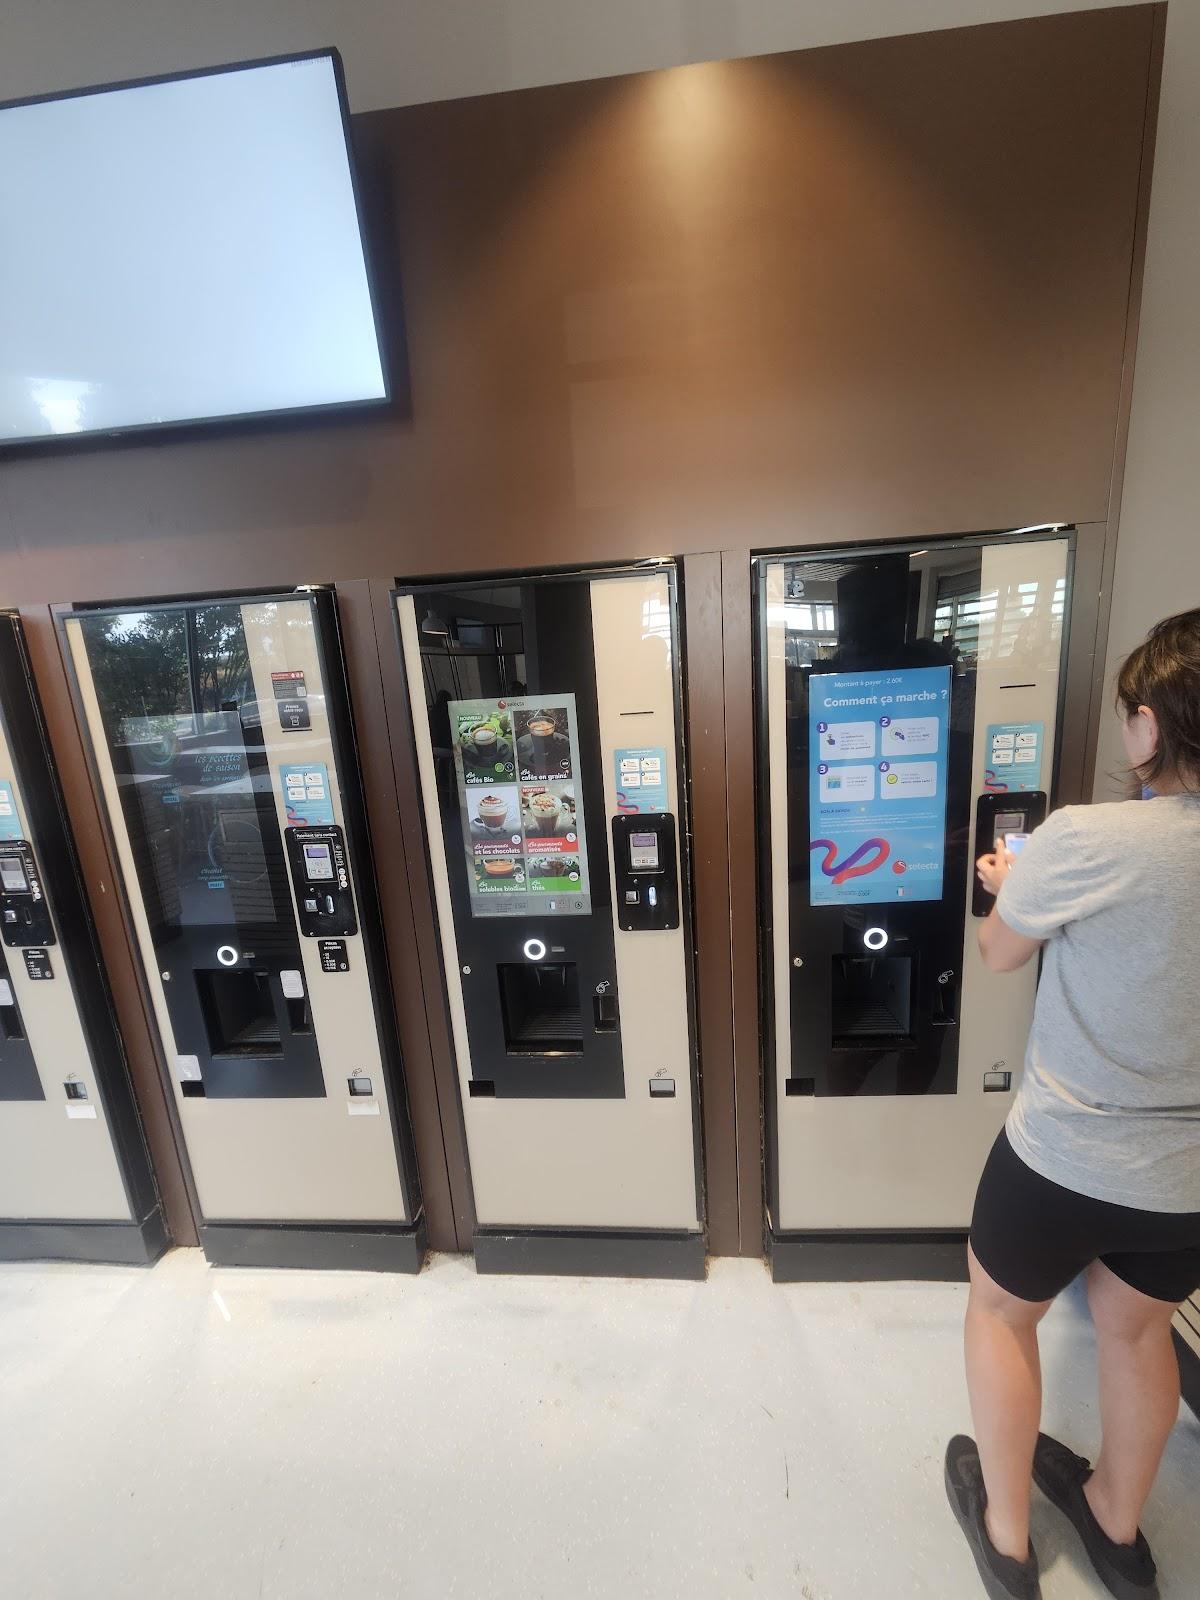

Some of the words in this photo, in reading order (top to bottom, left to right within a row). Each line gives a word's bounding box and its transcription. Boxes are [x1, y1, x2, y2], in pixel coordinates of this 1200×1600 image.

[823, 695, 878, 708] Comment
[881, 695, 893, 706] ça
[896, 690, 937, 703] marche
[941, 689, 948, 699] ?
[881, 717, 889, 726] 2
[819, 765, 826, 774] 3
[880, 762, 887, 771] 4
[466, 776, 483, 784] cafés
[521, 773, 538, 781] cafés
[547, 772, 567, 781] grains
[492, 847, 520, 855] chocolats
[906, 862, 939, 871] selecta
